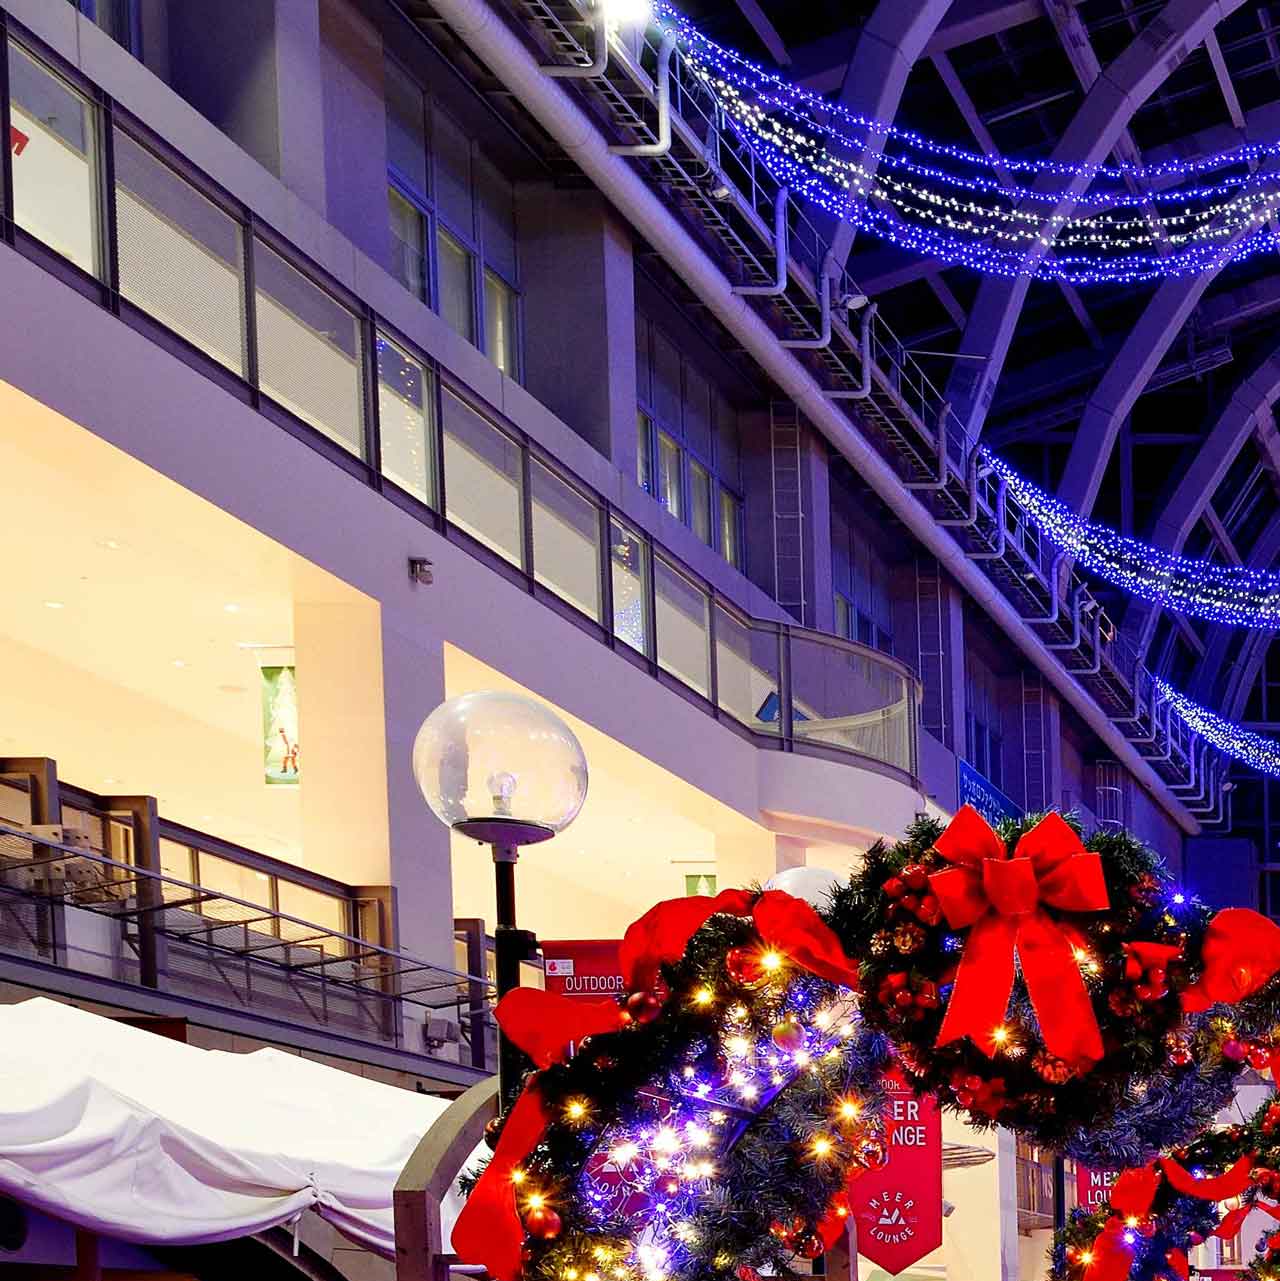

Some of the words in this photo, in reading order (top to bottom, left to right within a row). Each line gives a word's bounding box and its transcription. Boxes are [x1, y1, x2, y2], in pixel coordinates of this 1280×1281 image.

[565, 975, 625, 991] OUTDOOR
[893, 1100, 919, 1121] ER
[891, 1126, 926, 1146] NGE
[868, 1191, 914, 1210] MEER
[869, 1225, 914, 1244] LOUNGE
